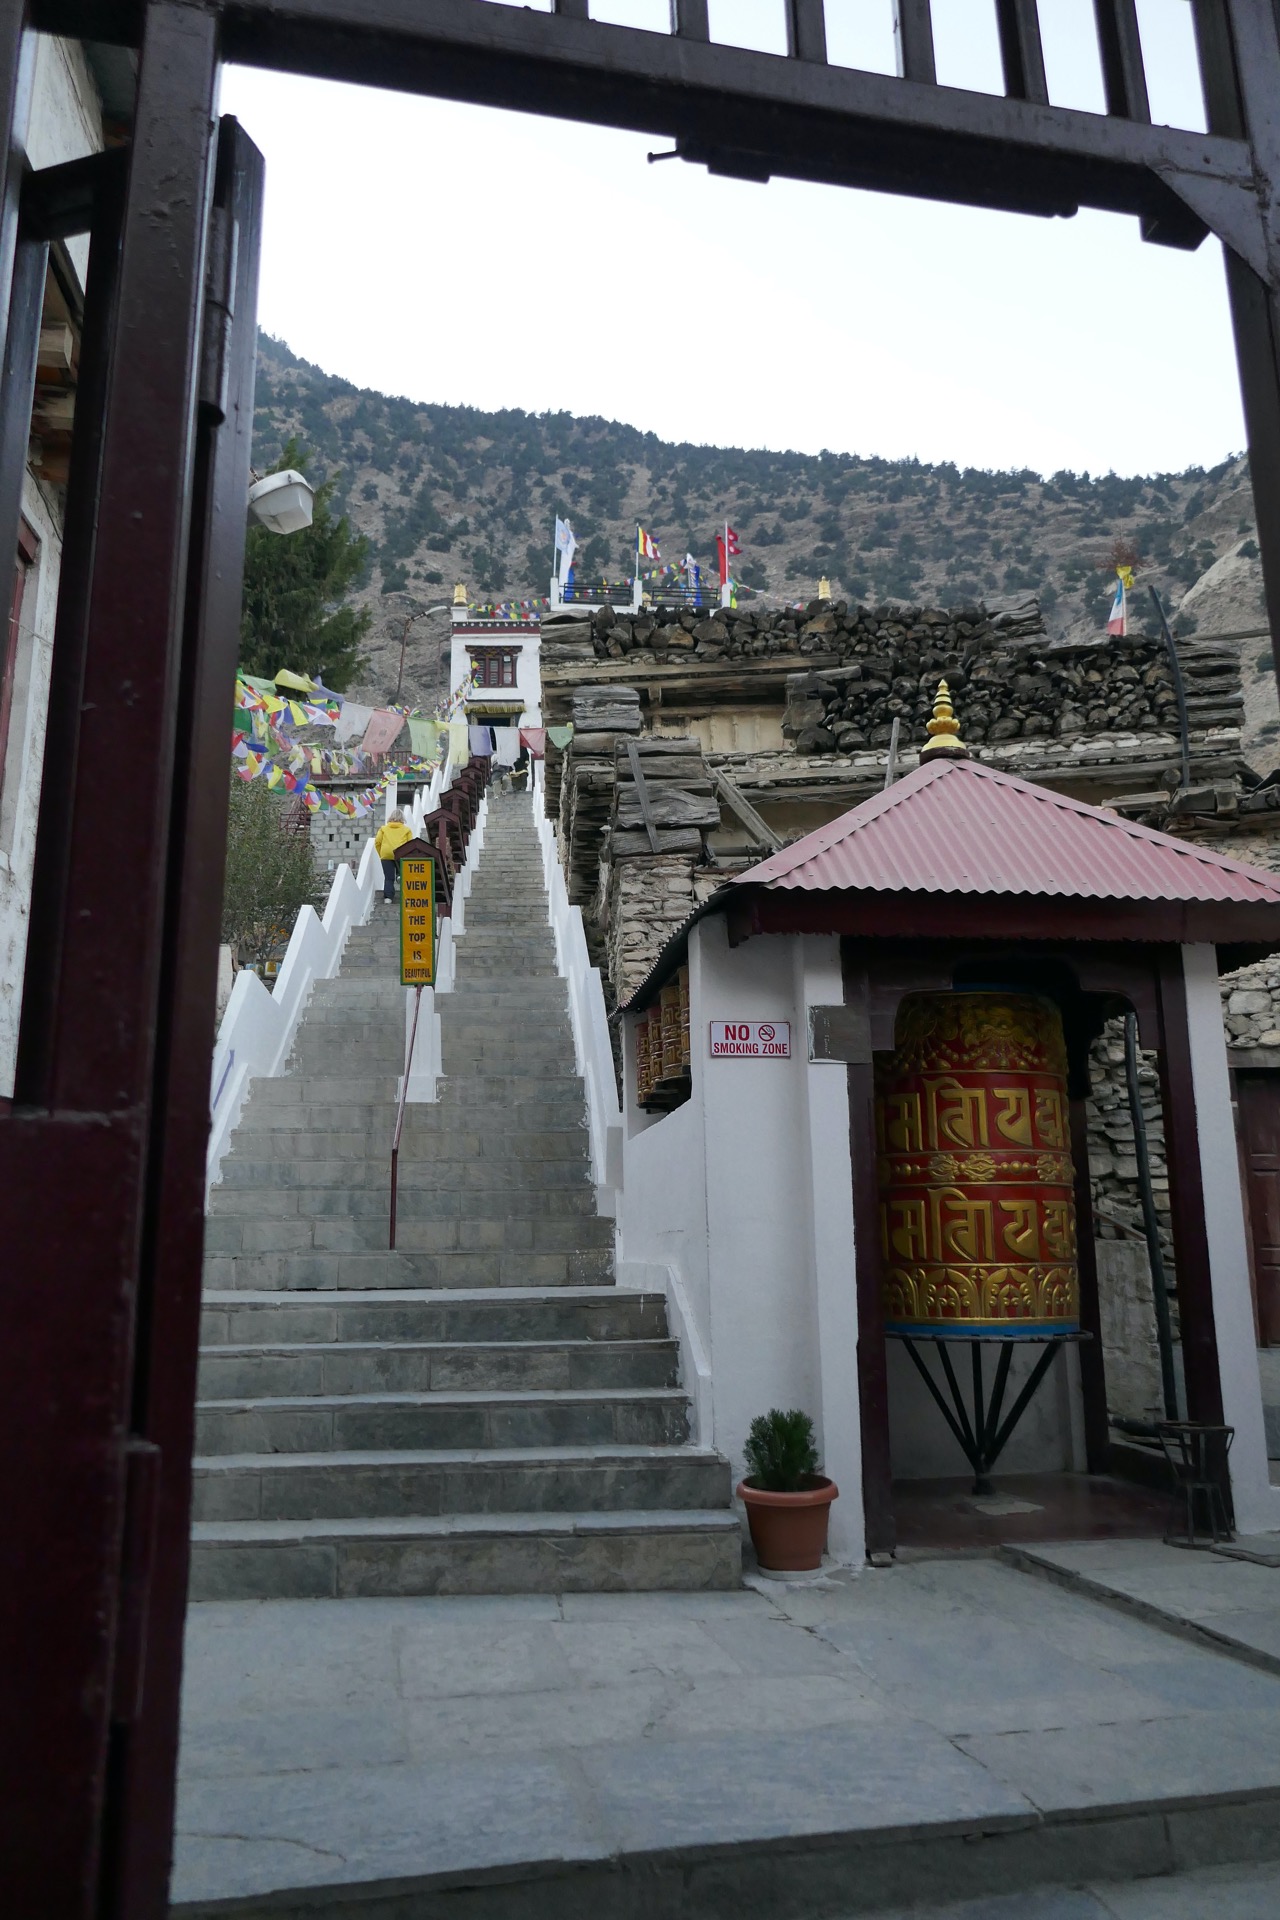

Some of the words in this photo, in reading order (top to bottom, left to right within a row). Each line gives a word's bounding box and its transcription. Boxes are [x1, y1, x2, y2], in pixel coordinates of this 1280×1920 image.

[408, 864, 425, 873] THE
[406, 881, 427, 890] VIEW
[405, 898, 429, 908] FROM
[408, 916, 425, 925] THE
[408, 933, 425, 942] TOP
[413, 950, 422, 960] IS
[404, 968, 431, 978] BEAUTIFUL
[724, 1024, 750, 1041] NO
[713, 1042, 759, 1054] SMOKING
[762, 1043, 788, 1054] ZONE
